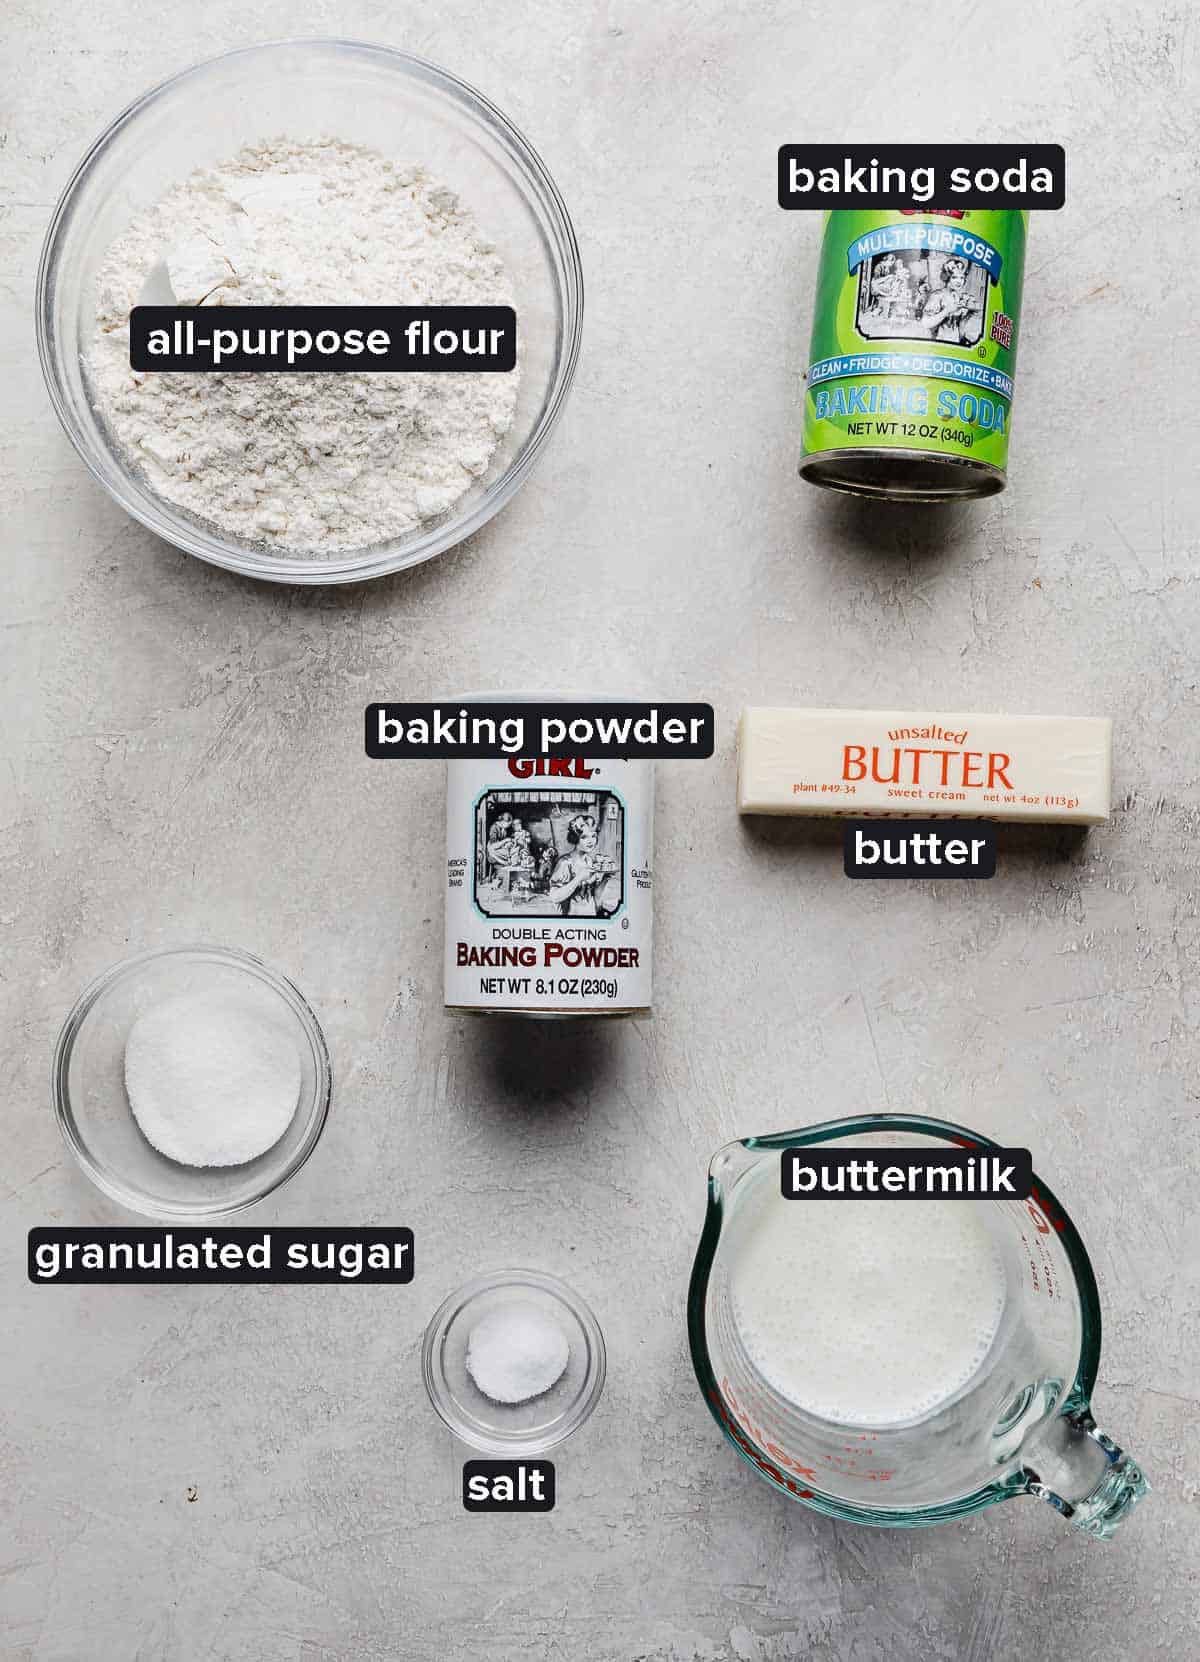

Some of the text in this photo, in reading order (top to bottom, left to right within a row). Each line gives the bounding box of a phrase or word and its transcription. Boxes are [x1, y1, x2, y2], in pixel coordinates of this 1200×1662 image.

[857, 228, 995, 266] MULTI-PURPOSE
[812, 360, 841, 379] CLEAN
[849, 357, 900, 371] FRIDGE
[912, 359, 990, 383] DEODORIZE
[816, 384, 1005, 436] BAKING SODA
[848, 422, 974, 447] NET WT 12 OZ (340g)
[888, 724, 968, 745] unsalted
[842, 745, 1014, 790] BUTTER
[793, 781, 857, 793] plant #49-34
[887, 788, 966, 801] sweet cream
[983, 793, 999, 802] net
[1004, 795, 1016, 803] wt
[1045, 795, 1079, 808] (113g)
[492, 928, 607, 941] DOUBLE ACTING
[456, 942, 641, 968] BAKING POWDER
[480, 978, 618, 998] NET WT 8.1 OZ (230g)
